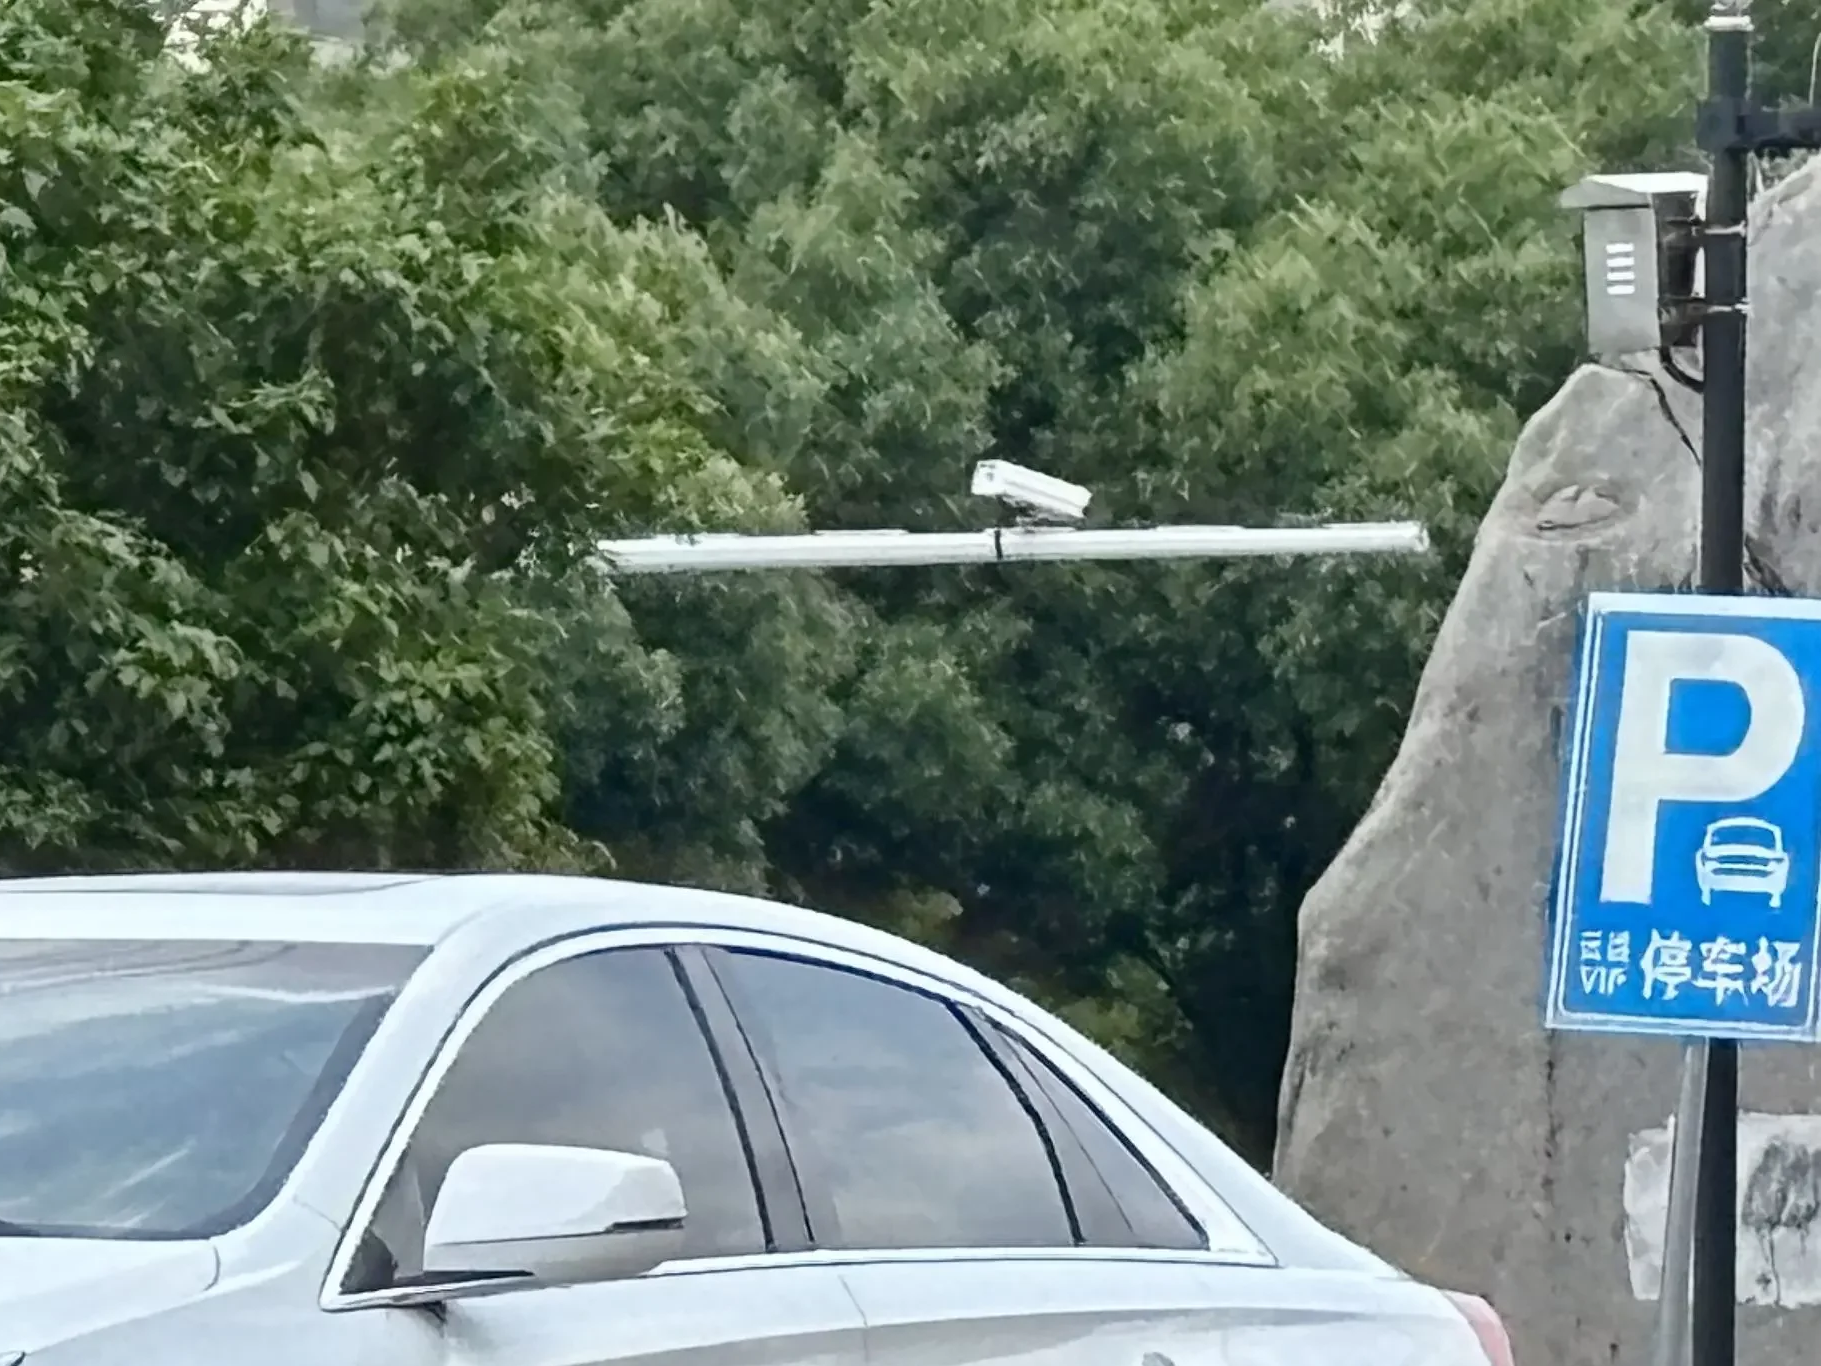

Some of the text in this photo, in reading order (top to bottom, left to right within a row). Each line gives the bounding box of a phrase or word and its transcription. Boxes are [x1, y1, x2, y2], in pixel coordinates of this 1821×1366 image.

[1600, 630, 1805, 904] P
[1580, 964, 1628, 996] VIP
[1640, 928, 1803, 1007] 停车场
